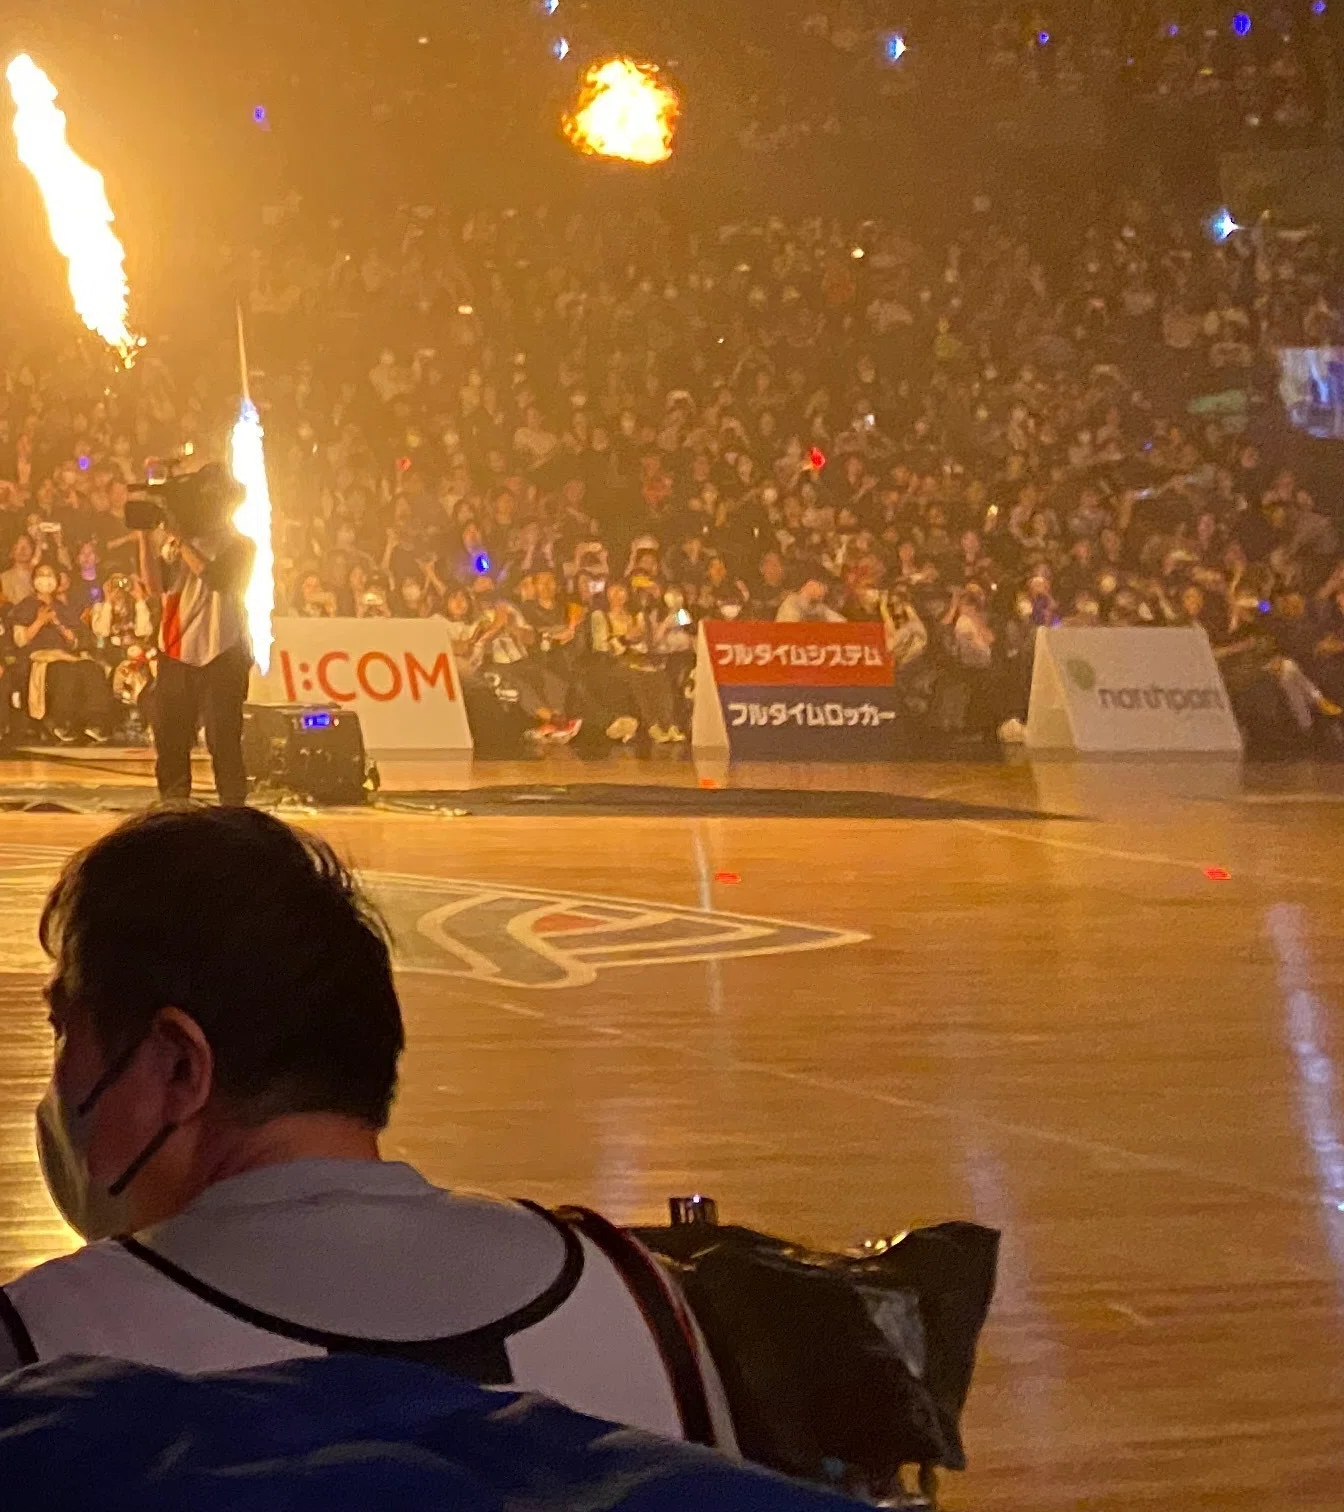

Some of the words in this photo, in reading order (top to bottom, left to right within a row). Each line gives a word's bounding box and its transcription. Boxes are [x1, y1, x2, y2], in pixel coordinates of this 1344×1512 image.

[715, 643, 884, 667] フルタイムシステム
[728, 701, 896, 727] フルタイムロッカー
